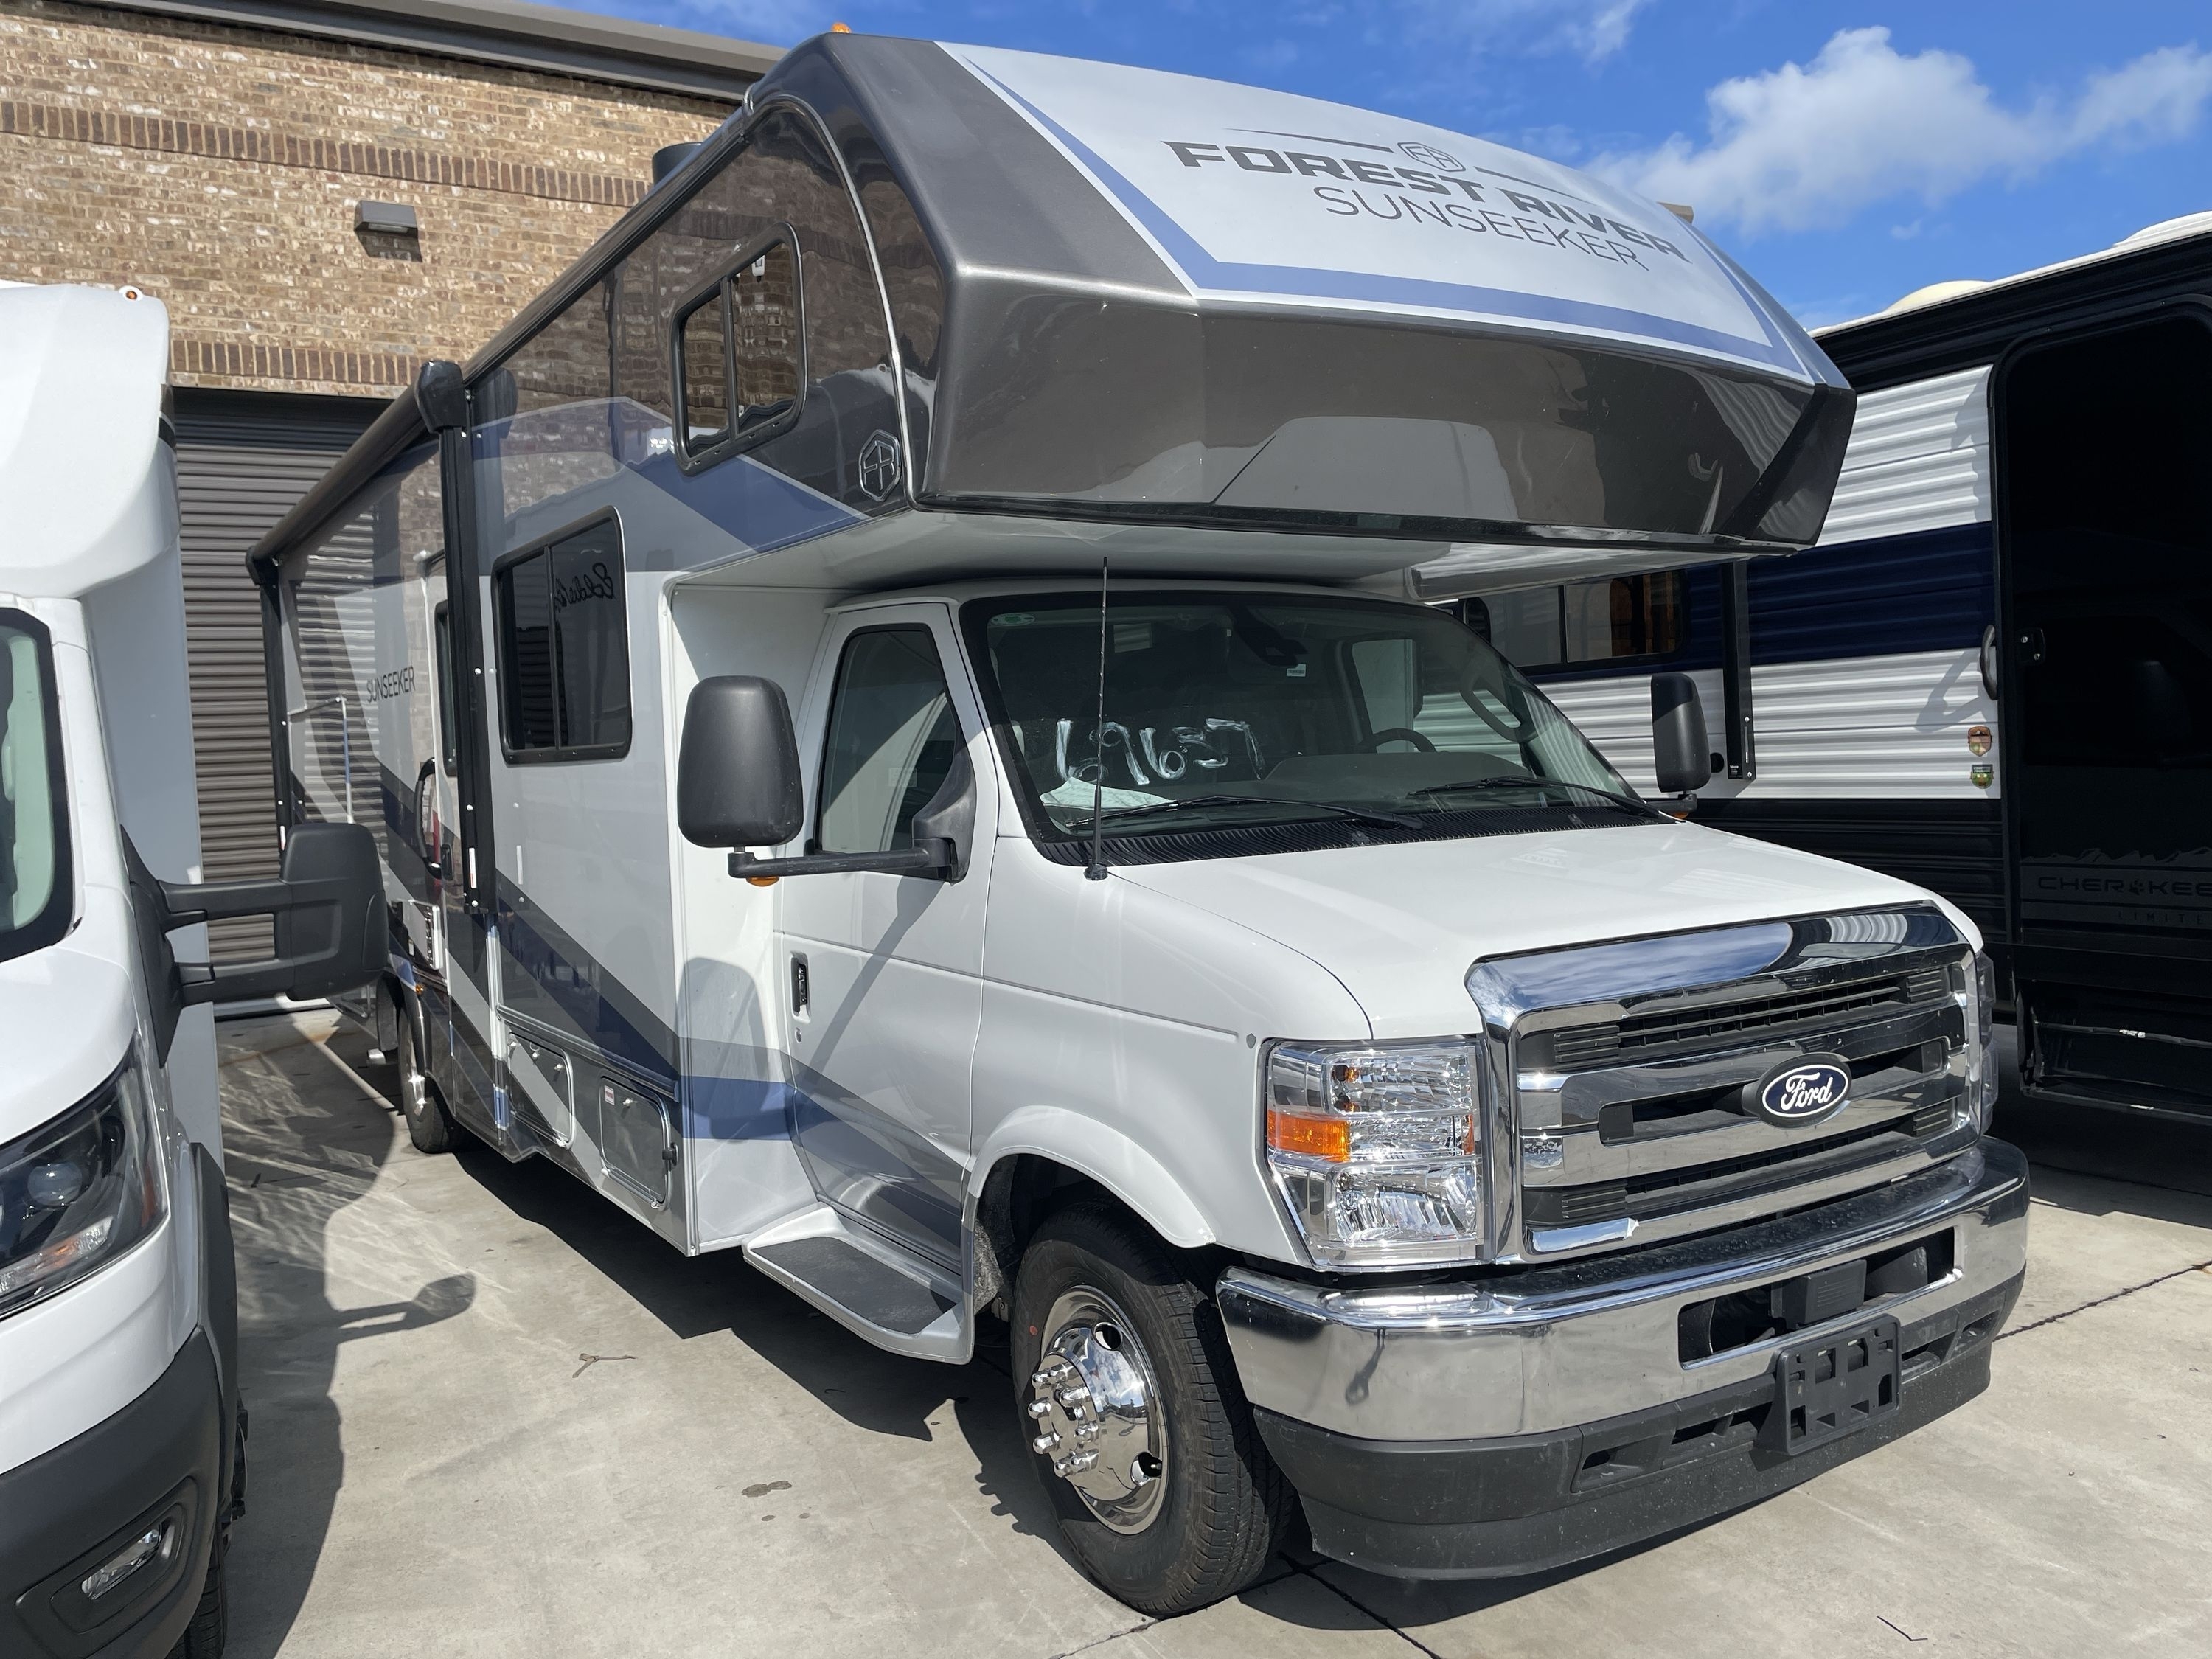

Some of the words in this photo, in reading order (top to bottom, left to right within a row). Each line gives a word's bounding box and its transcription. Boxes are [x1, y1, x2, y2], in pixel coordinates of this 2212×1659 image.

[1161, 140, 1485, 203] FOREST
[1495, 187, 1693, 264] RIVER
[1314, 187, 1649, 271] SUNSEEKER
[366, 665, 416, 703] SUNSEEKER
[1780, 1071, 1833, 1110] Ford
